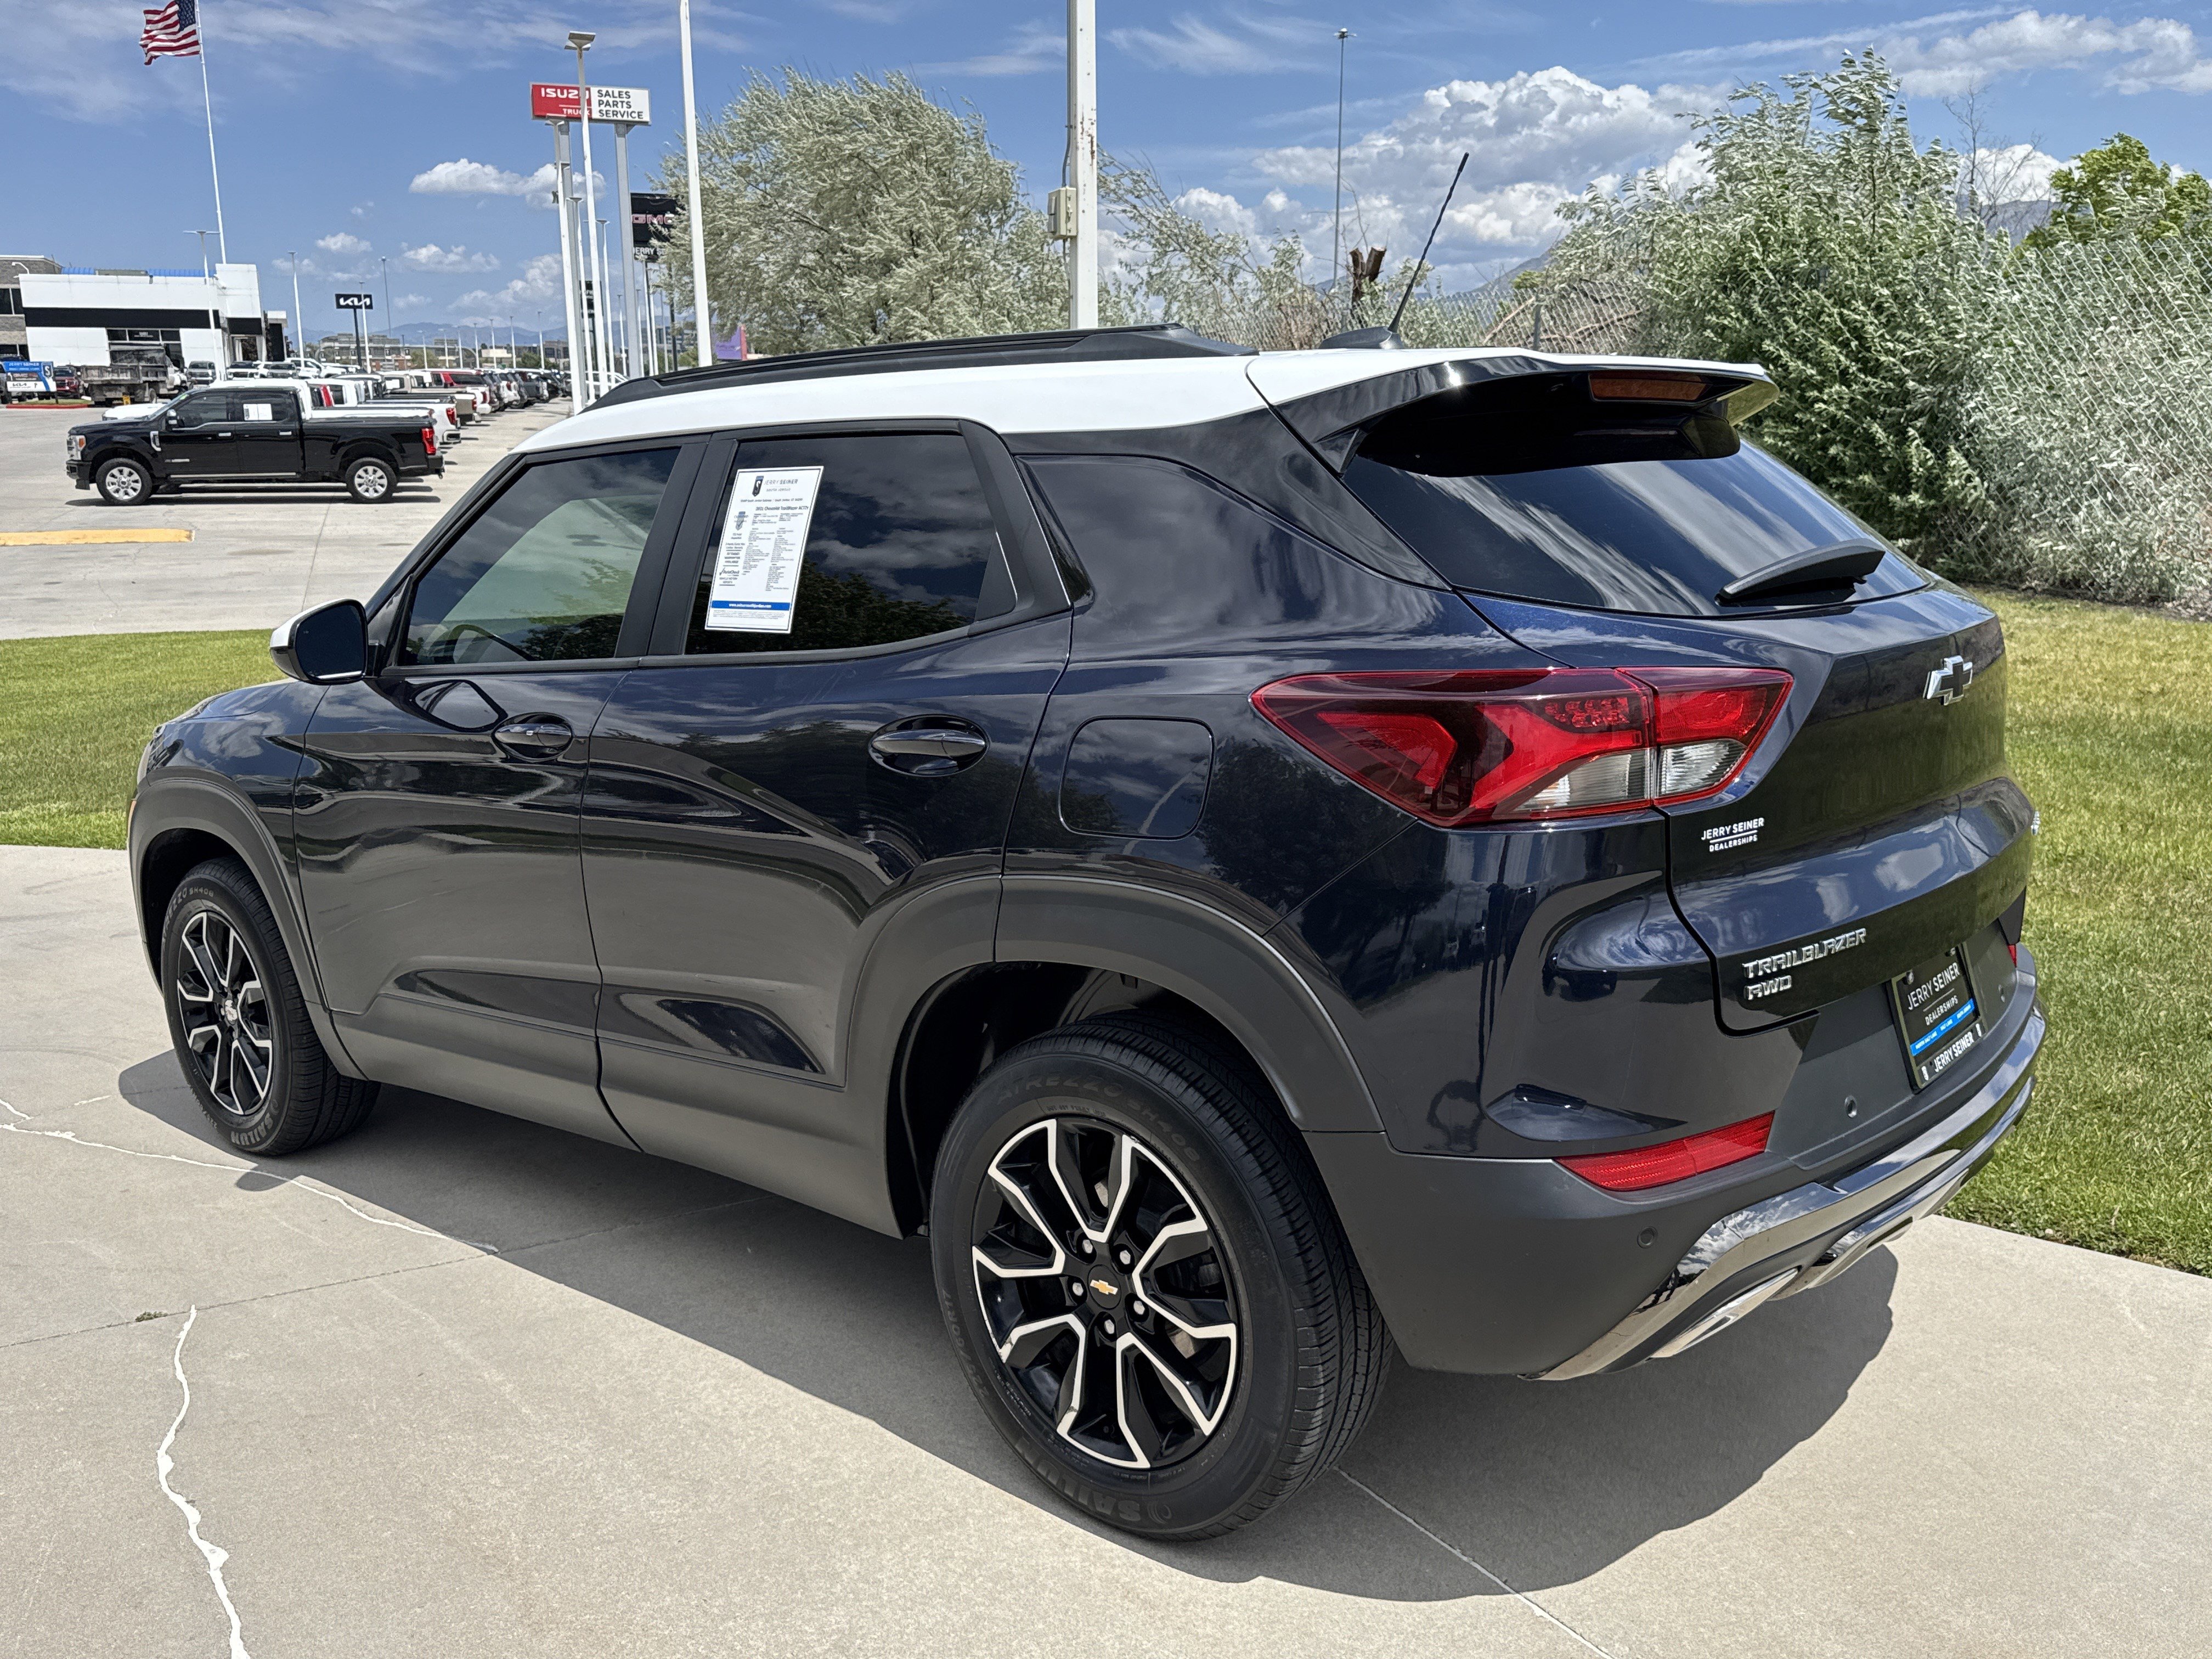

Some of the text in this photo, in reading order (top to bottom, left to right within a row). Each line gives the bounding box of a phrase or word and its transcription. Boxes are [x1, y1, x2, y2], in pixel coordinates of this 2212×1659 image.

[597, 89, 630, 99] SALES
[598, 99, 631, 109] PARTS
[599, 109, 644, 119] SERVICE
[1701, 817, 1764, 840] JERRY SEINER
[1709, 834, 1758, 852] DEALERSHIPS
[1742, 928, 1866, 979] TRAILBLAZER
[1744, 975, 1792, 1001] AWD
[1907, 962, 1961, 1011] JERRY SEINER
[1925, 995, 1959, 1026] DEALERSHIPS
[1934, 1047, 1954, 1073] JERRY
[1952, 1031, 1975, 1057] SEINER
